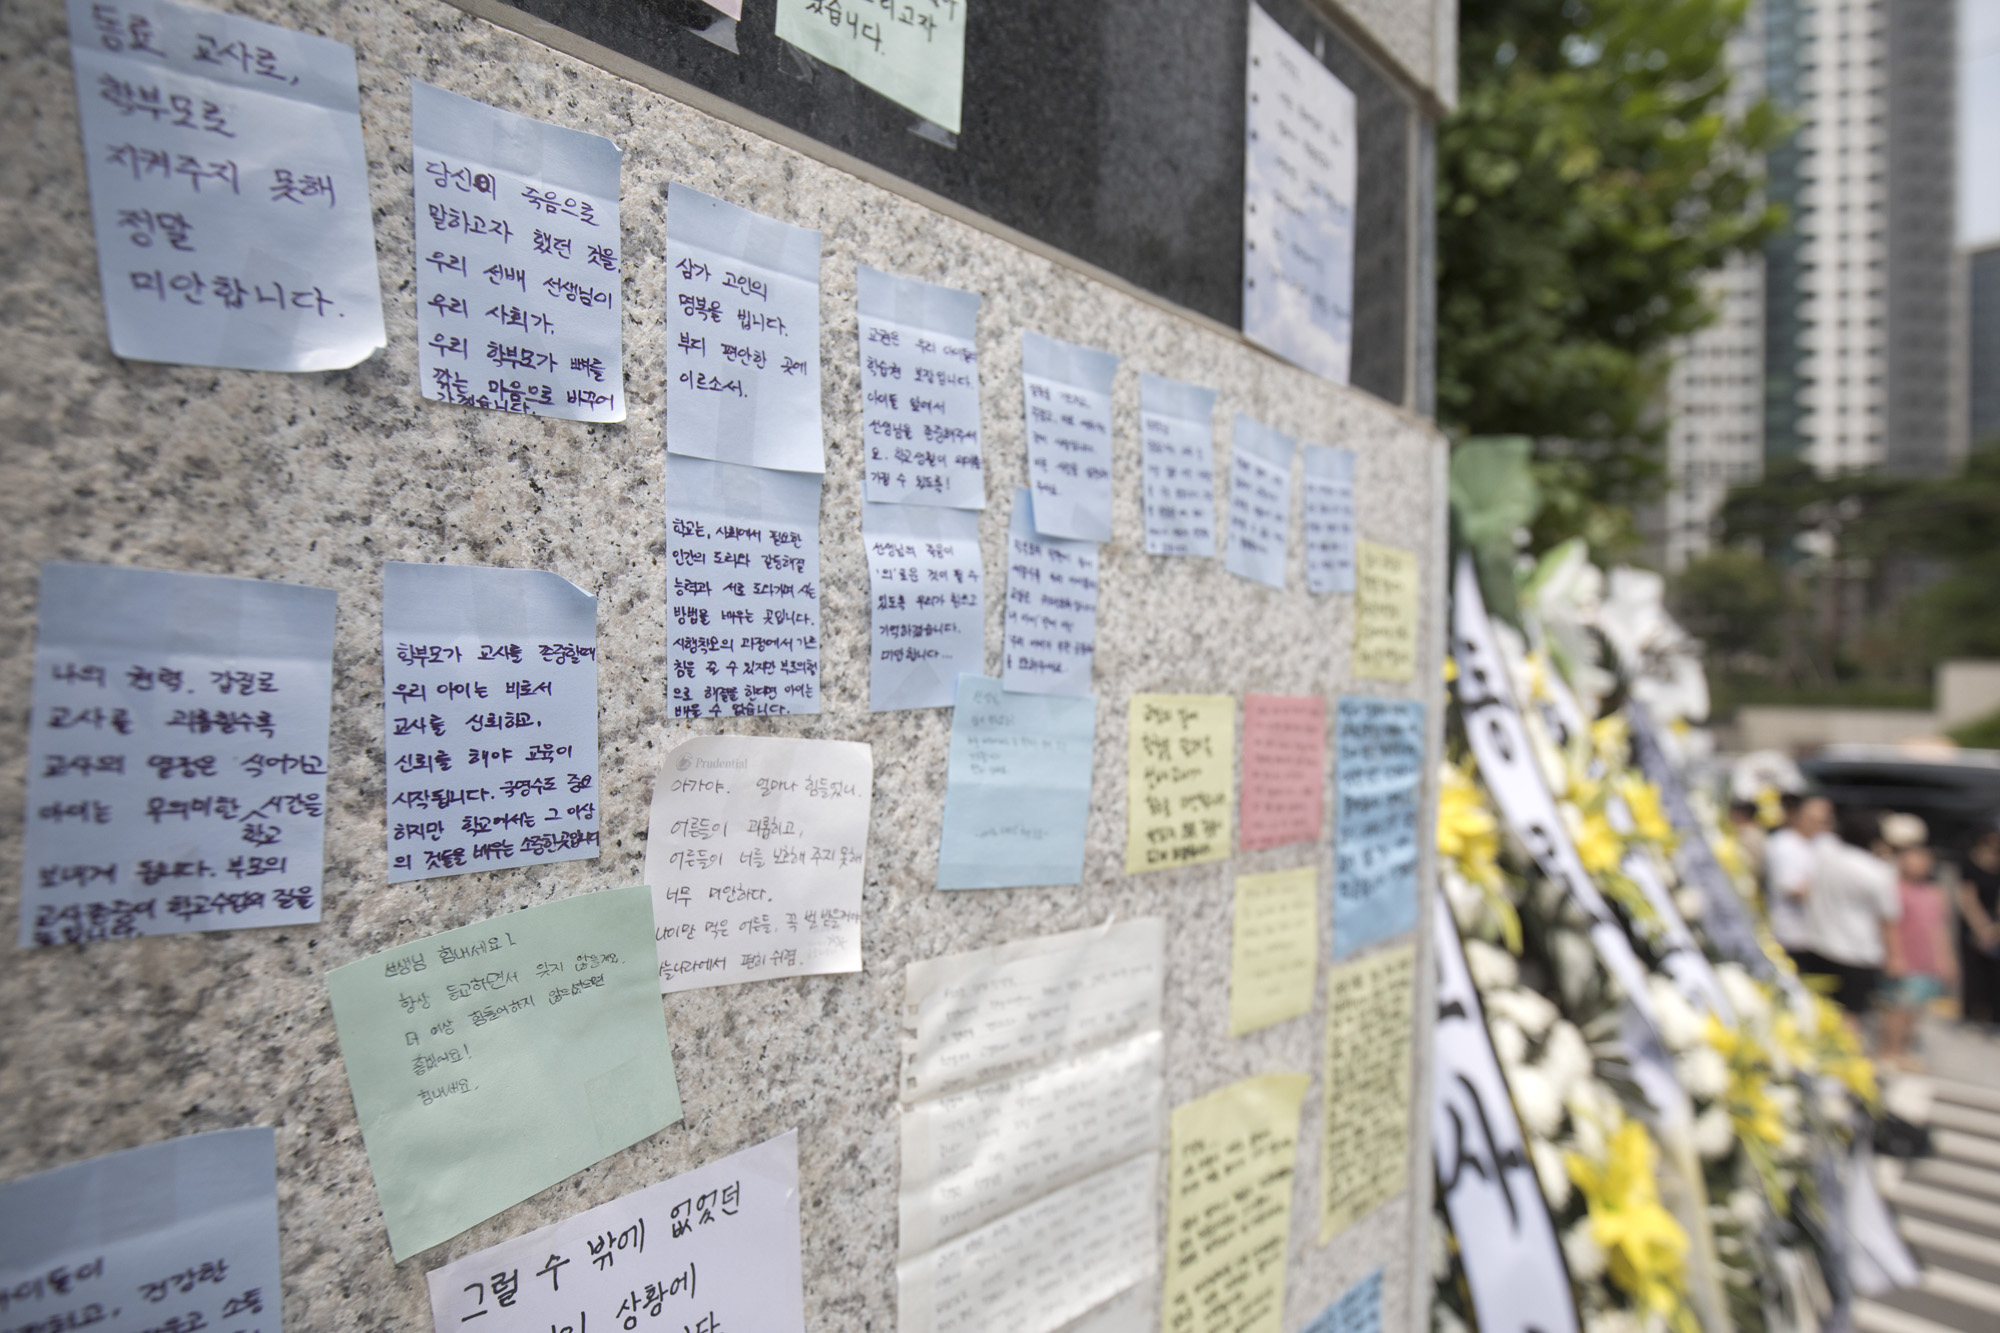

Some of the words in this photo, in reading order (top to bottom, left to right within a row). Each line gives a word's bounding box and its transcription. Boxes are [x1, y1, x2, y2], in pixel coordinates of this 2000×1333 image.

[99, 73, 236, 139] 학부모로
[106, 143, 240, 195] 지켜주지
[269, 168, 337, 208] 못해
[521, 186, 600, 227] 죽음으로
[117, 208, 196, 252] 정말
[428, 203, 514, 244] 말하고자
[532, 229, 572, 259] 했던
[130, 270, 345, 318] 미안합니다.
[425, 251, 467, 277] 우리
[483, 264, 526, 292] 선배
[542, 277, 612, 310] 선생님이
[675, 258, 712, 282] 삼가
[722, 271, 767, 302] 고인의
[427, 293, 469, 319] 우리
[678, 294, 723, 323] 명복을
[737, 308, 789, 337] 빕니다.
[428, 333, 468, 360] 우리
[486, 341, 558, 373] 학부모가
[720, 343, 767, 369] 편안한
[780, 356, 807, 375] 곳에
[915, 338, 936, 353] 우리
[488, 379, 555, 406] 마음으로
[566, 389, 614, 411] 바꾸어
[679, 370, 748, 398] 이르소서.
[867, 389, 899, 410] 아이들
[910, 396, 946, 414] 앞에서
[868, 419, 913, 440] 선생님을
[896, 473, 907, 487] 수
[672, 518, 711, 540] 학교는,
[715, 525, 762, 542] 사회에서
[769, 529, 802, 548] 필요한
[672, 549, 706, 566] 인간의
[713, 552, 751, 568] 도리와
[872, 542, 917, 558] 선생님의
[925, 543, 954, 559] 죽음이
[673, 578, 712, 597] 능력과
[722, 581, 746, 597] 서로
[927, 569, 948, 582] 것이
[968, 570, 979, 583] 수
[673, 606, 710, 625] 방법을
[721, 609, 754, 625] 배우는
[763, 609, 815, 627] 곳입니다.
[877, 594, 906, 611] 있도록
[916, 594, 945, 609] 우리가
[397, 642, 463, 667] 학부모가
[477, 643, 523, 663] 교사를
[672, 636, 734, 654] 시행착오의
[740, 637, 793, 652] 과정에서
[52, 662, 107, 689] 나의
[211, 669, 280, 696] 갑질로
[673, 660, 696, 678] 침을
[726, 661, 739, 677] 수
[743, 660, 776, 676] 있지만
[392, 682, 426, 705] 우리
[436, 681, 489, 699] 아이는
[505, 680, 553, 699] 비로서
[673, 687, 693, 700] 으로
[744, 685, 778, 700] 한다면
[784, 684, 813, 699] 아이는
[47, 706, 134, 736] 교사를
[166, 708, 276, 738] 괴롭힐수록
[674, 703, 702, 718] 배울
[708, 703, 722, 718] 수
[732, 702, 791, 716] 없습니다.
[393, 714, 447, 736] 교사를
[41, 754, 127, 779] 교사의
[146, 754, 219, 780] 열정은
[394, 750, 453, 774] 신뢰를
[468, 747, 513, 767] 해야
[525, 743, 573, 763] 교육이
[695, 757, 748, 770] Prudential
[392, 787, 495, 809] 시작됩니다.
[499, 775, 558, 798] 국영수도
[567, 773, 593, 794] 중요
[671, 779, 731, 794] 아가야.
[756, 777, 798, 797] 얼마나
[38, 801, 114, 825] 아이는
[145, 795, 242, 824] 무의미한
[260, 792, 324, 817] 시간을
[394, 819, 445, 842] 하지만
[462, 811, 536, 837] 학교에서는
[544, 806, 562, 823] 그
[567, 802, 596, 820] 이상
[670, 817, 728, 840] 어른들이
[226, 855, 287, 880] 부모의
[393, 852, 411, 871] 의
[424, 847, 468, 871] 것들을
[473, 839, 515, 860] 배우는
[669, 849, 723, 871] 어른들이
[739, 848, 766, 867] 너를
[810, 846, 835, 867] 주지
[840, 845, 863, 867] 못해
[272, 885, 314, 910] 질을
[666, 886, 693, 907] 너무
[708, 883, 773, 902] 미안하다.
[655, 923, 696, 942] 나이만
[705, 919, 729, 940] 먹은
[786, 913, 798, 933] 꼭
[384, 952, 428, 979] 선생님
[437, 932, 517, 965] 힘내세요!
[740, 953, 766, 970] 편히
[398, 992, 431, 1014] 항상
[446, 970, 520, 1002] 등교하면서
[536, 961, 565, 979] 잊지
[430, 1019, 456, 1036] 이상
[468, 995, 536, 1028] 힘들어하지
[461, 1268, 519, 1323] 그럴
[536, 1253, 571, 1292] 수
[587, 1217, 646, 1272] 밖에
[670, 1179, 741, 1239] 없었던
[137, 1257, 230, 1303] 건강한
[221, 1286, 263, 1319] 소통
[616, 1262, 697, 1331] 상황에
